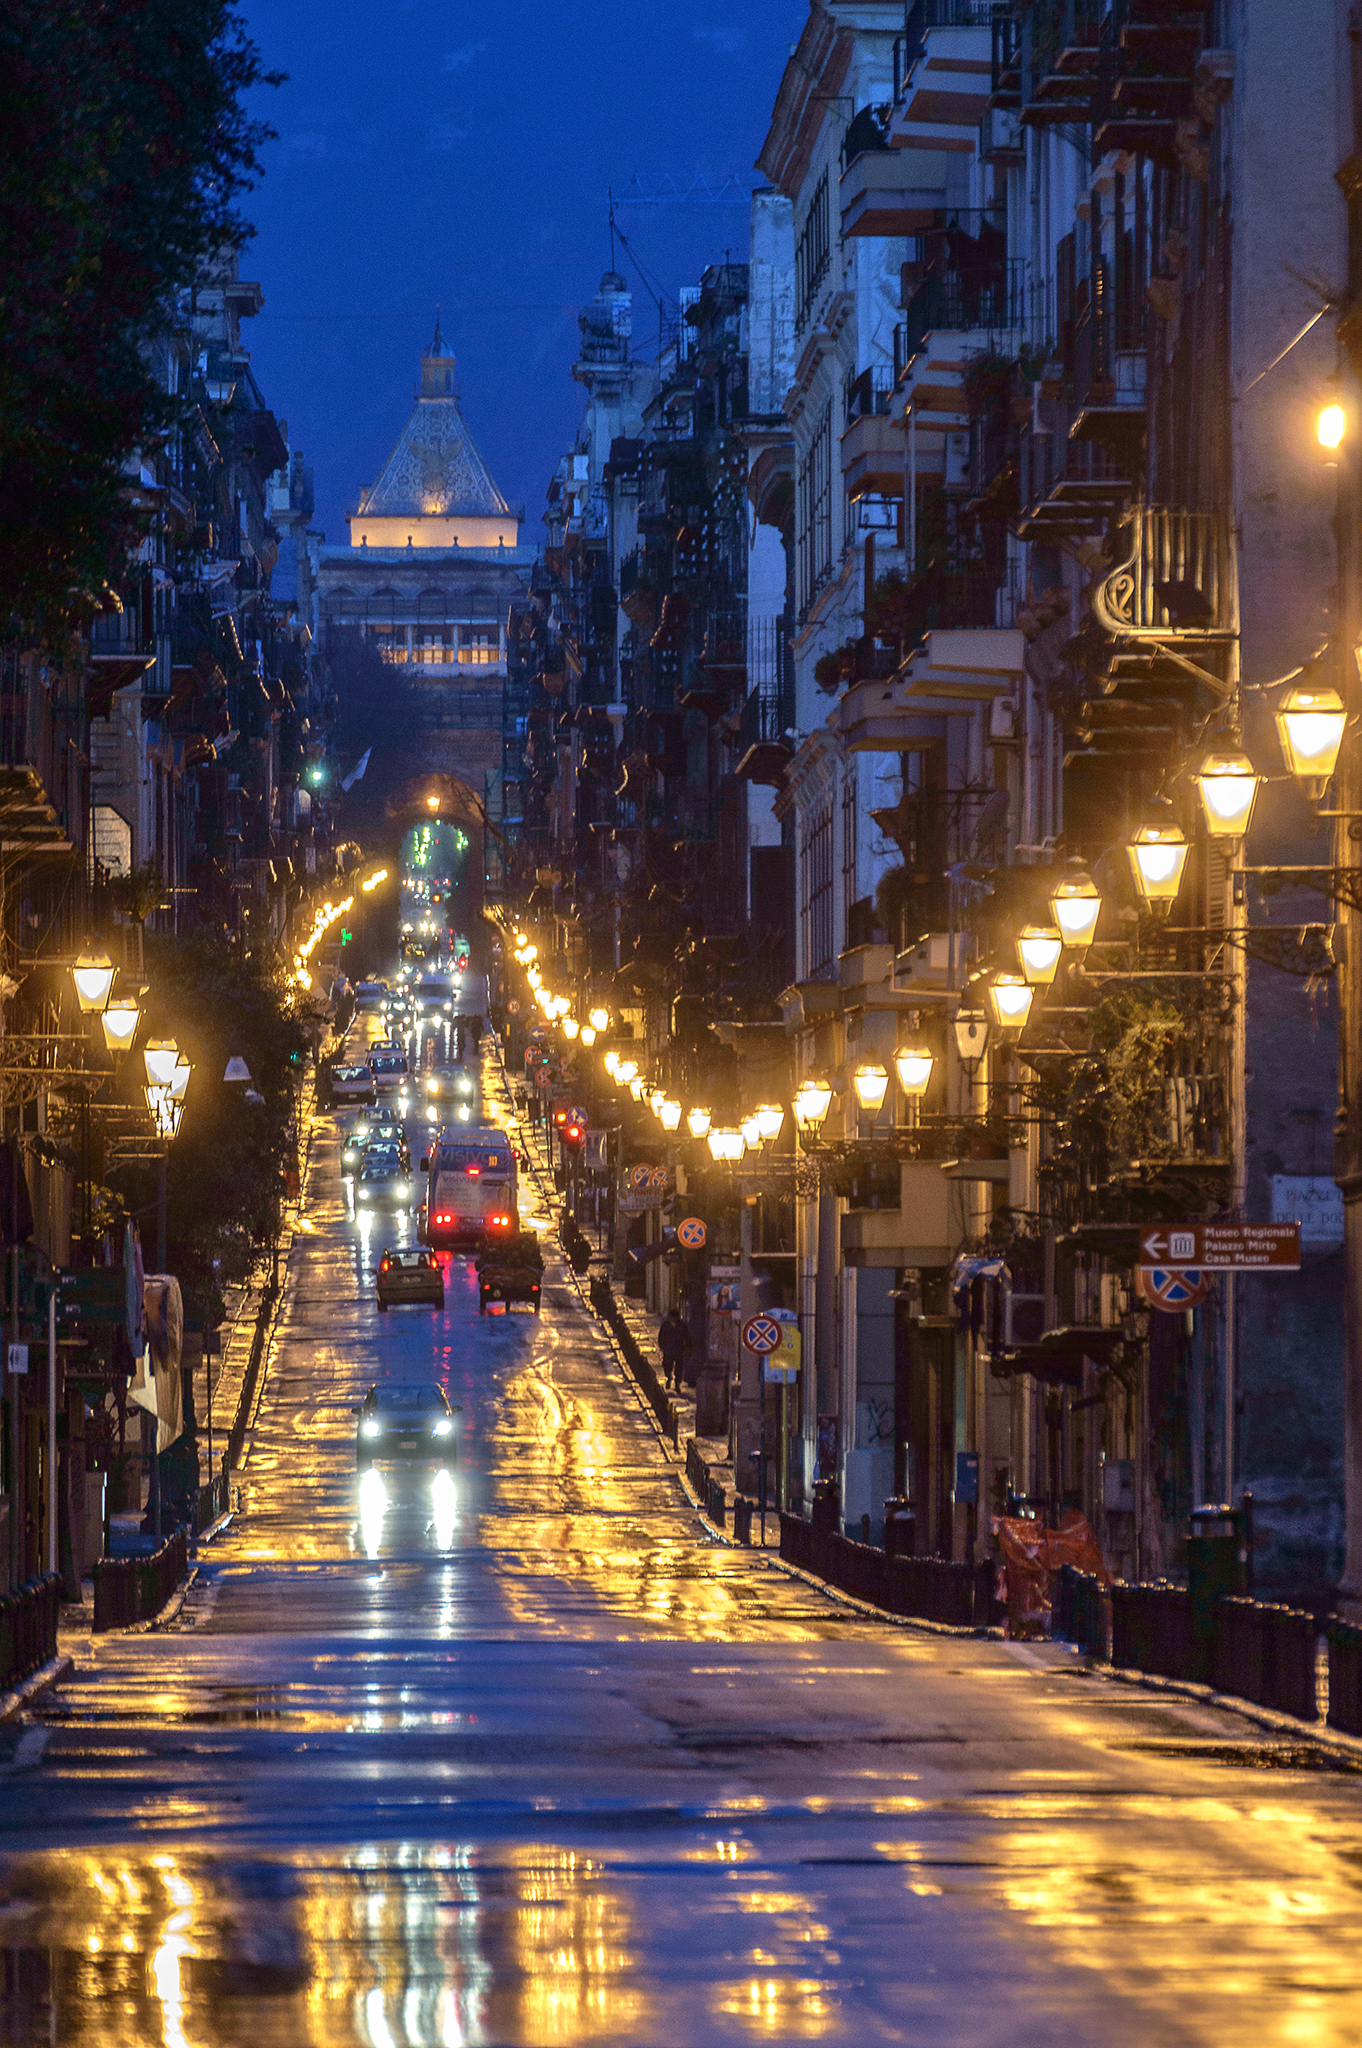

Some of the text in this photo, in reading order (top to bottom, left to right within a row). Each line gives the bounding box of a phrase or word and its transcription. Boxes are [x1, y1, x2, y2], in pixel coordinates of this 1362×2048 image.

[1204, 1227, 1240, 1237] Museo
[1243, 1227, 1296, 1239] Regionale
[1204, 1240, 1278, 1251] Palazzo Mirto
[1204, 1253, 1271, 1264] Casa Museo
